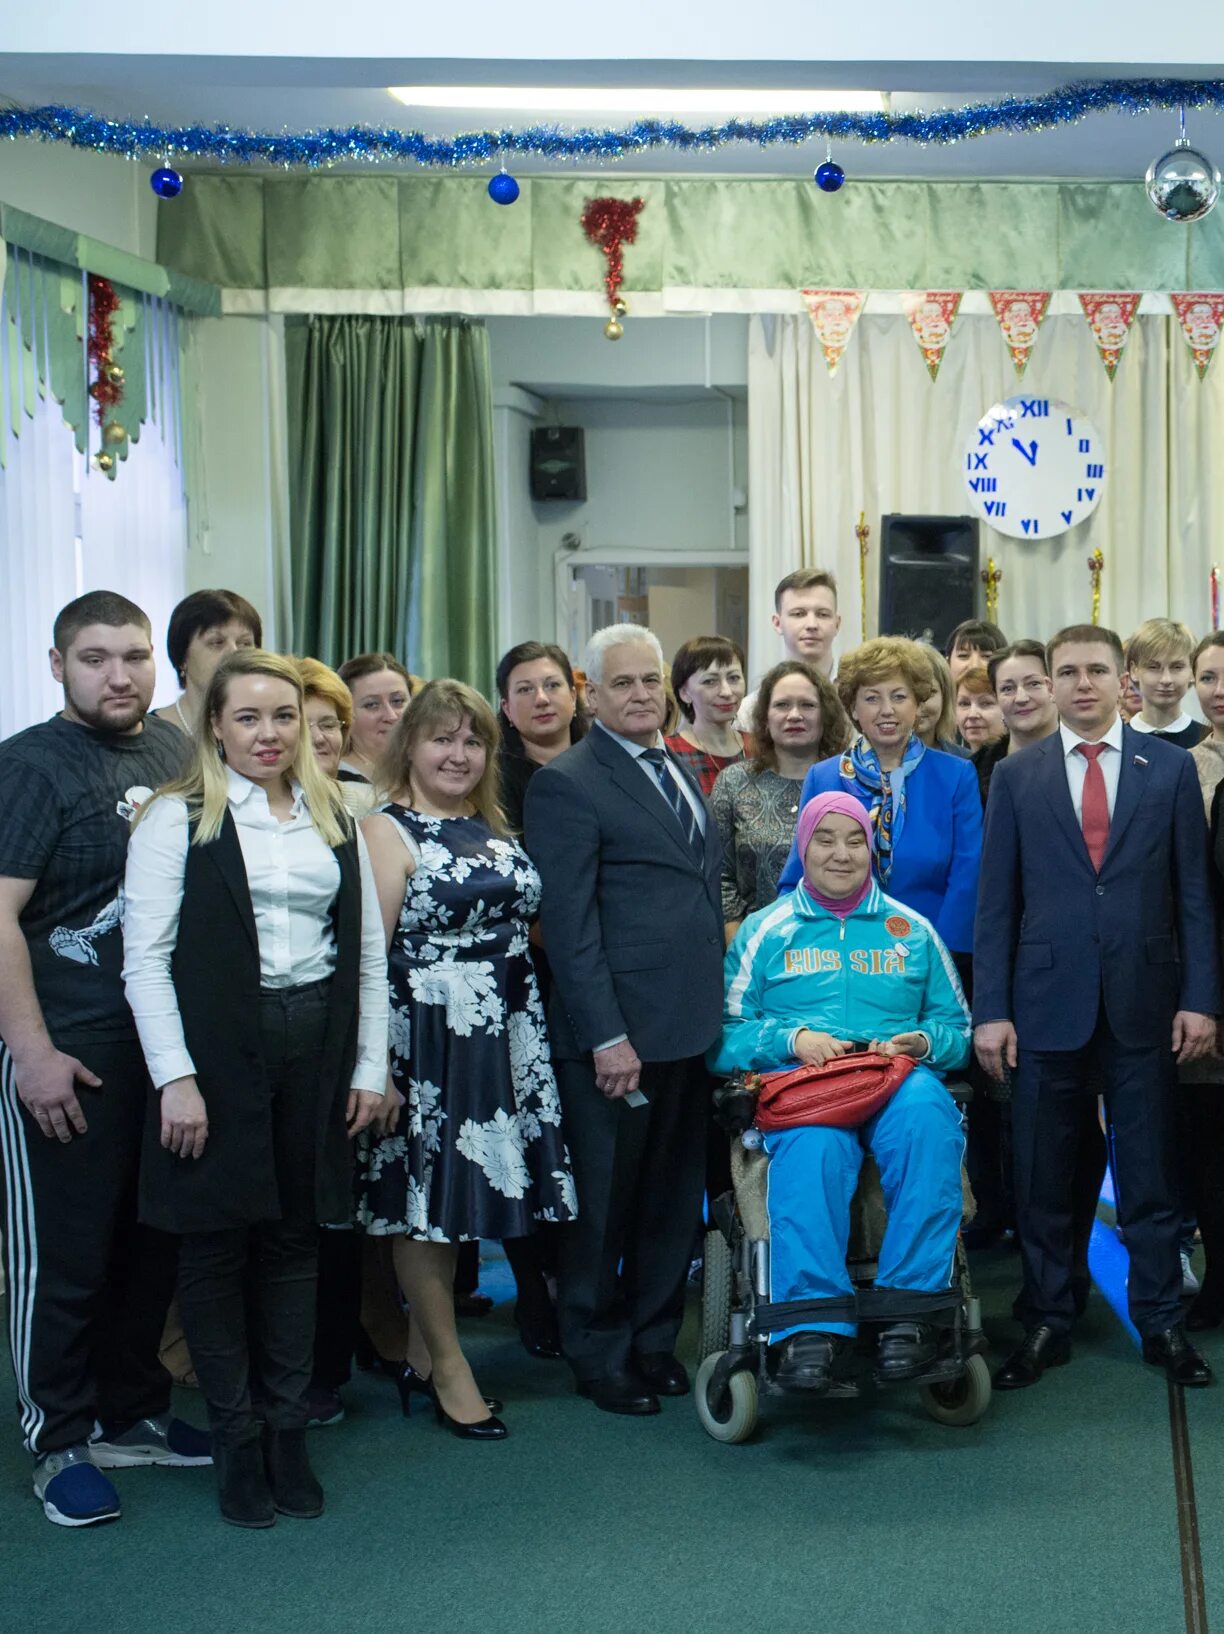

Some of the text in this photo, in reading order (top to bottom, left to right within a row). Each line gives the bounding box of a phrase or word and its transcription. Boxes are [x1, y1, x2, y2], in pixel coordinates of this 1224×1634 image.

[1020, 400, 1049, 418] XII
[1065, 418, 1073, 436] I
[978, 428, 995, 446] X
[1078, 439, 1090, 453] II
[967, 452, 989, 470] IX
[1086, 463, 1104, 479] III
[968, 477, 997, 493] VIII
[1077, 488, 1096, 502] IV
[983, 500, 1007, 517] VII
[1060, 509, 1073, 526] V
[1020, 519, 1039, 535] VI
